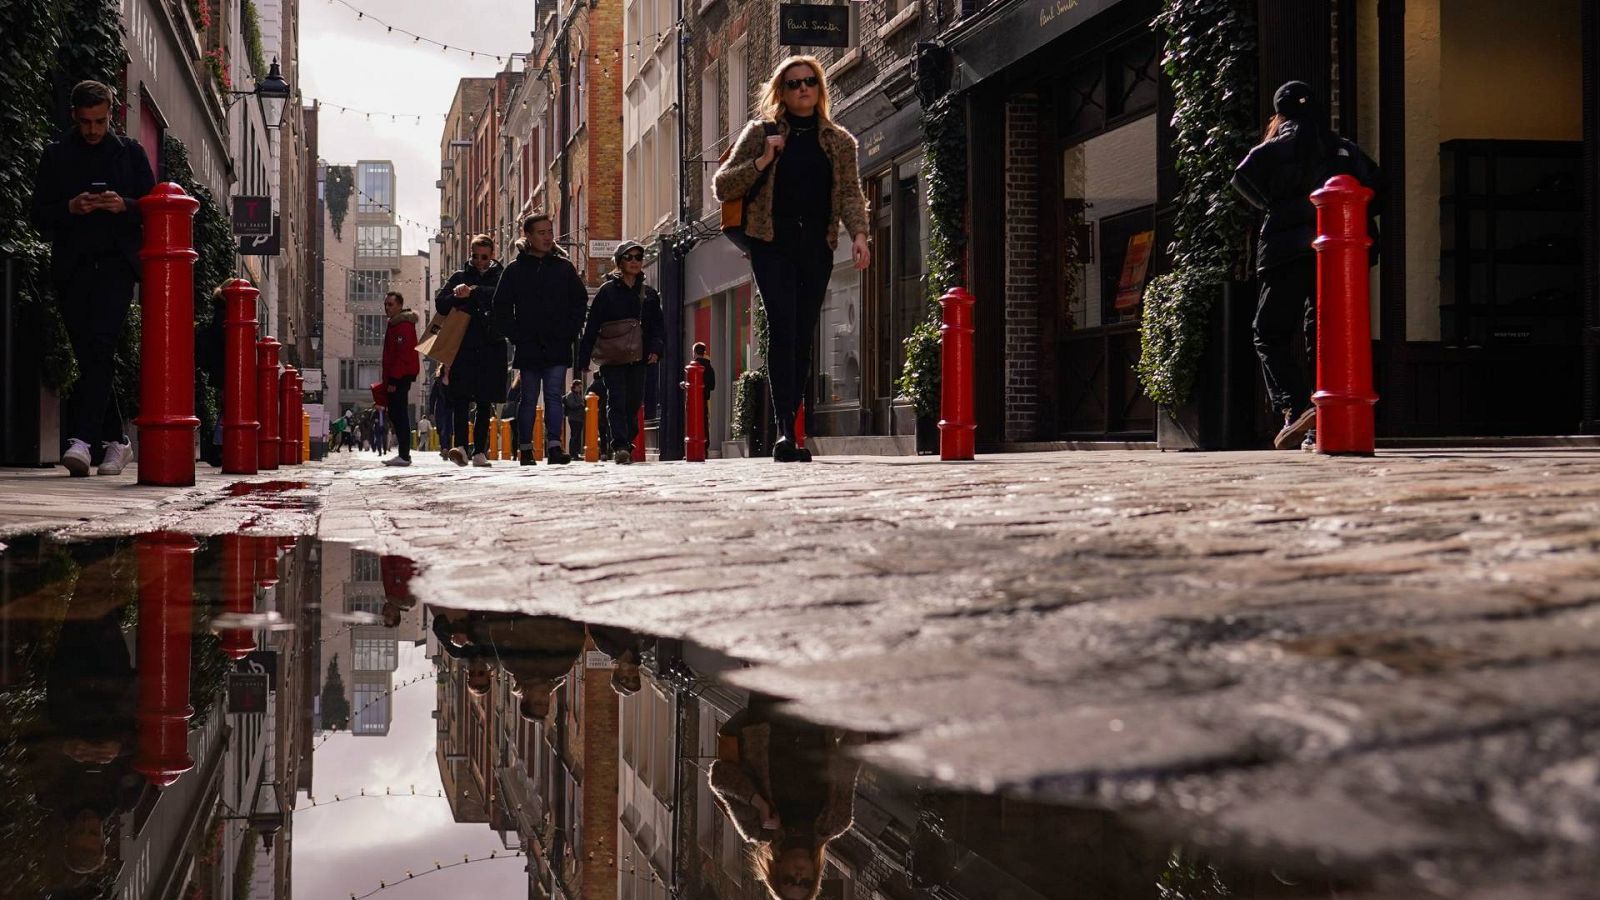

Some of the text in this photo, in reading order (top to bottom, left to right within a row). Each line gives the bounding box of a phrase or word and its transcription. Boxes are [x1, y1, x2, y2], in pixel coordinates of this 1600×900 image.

[1040, 0, 1079, 28] Paul Smith
[787, 18, 841, 32] Paul Smith
